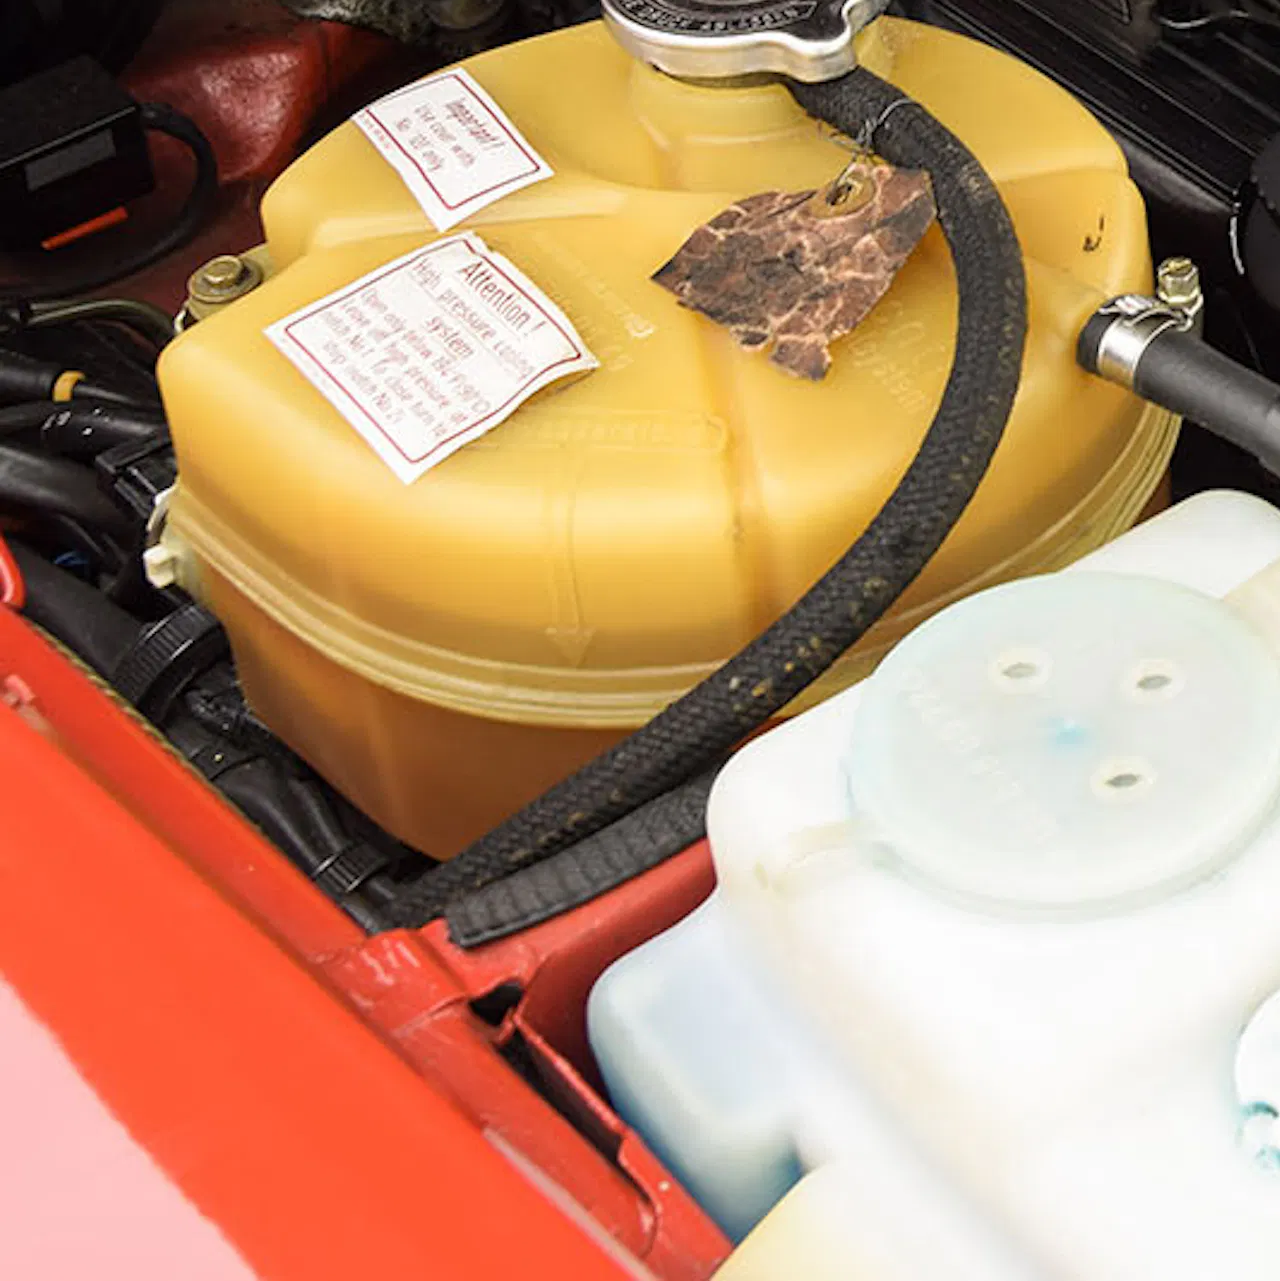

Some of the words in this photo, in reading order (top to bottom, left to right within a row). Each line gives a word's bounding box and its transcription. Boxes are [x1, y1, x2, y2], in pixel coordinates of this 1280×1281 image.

[436, 289, 496, 340] pressure
[460, 261, 530, 327] Attention
[426, 317, 474, 358] system
